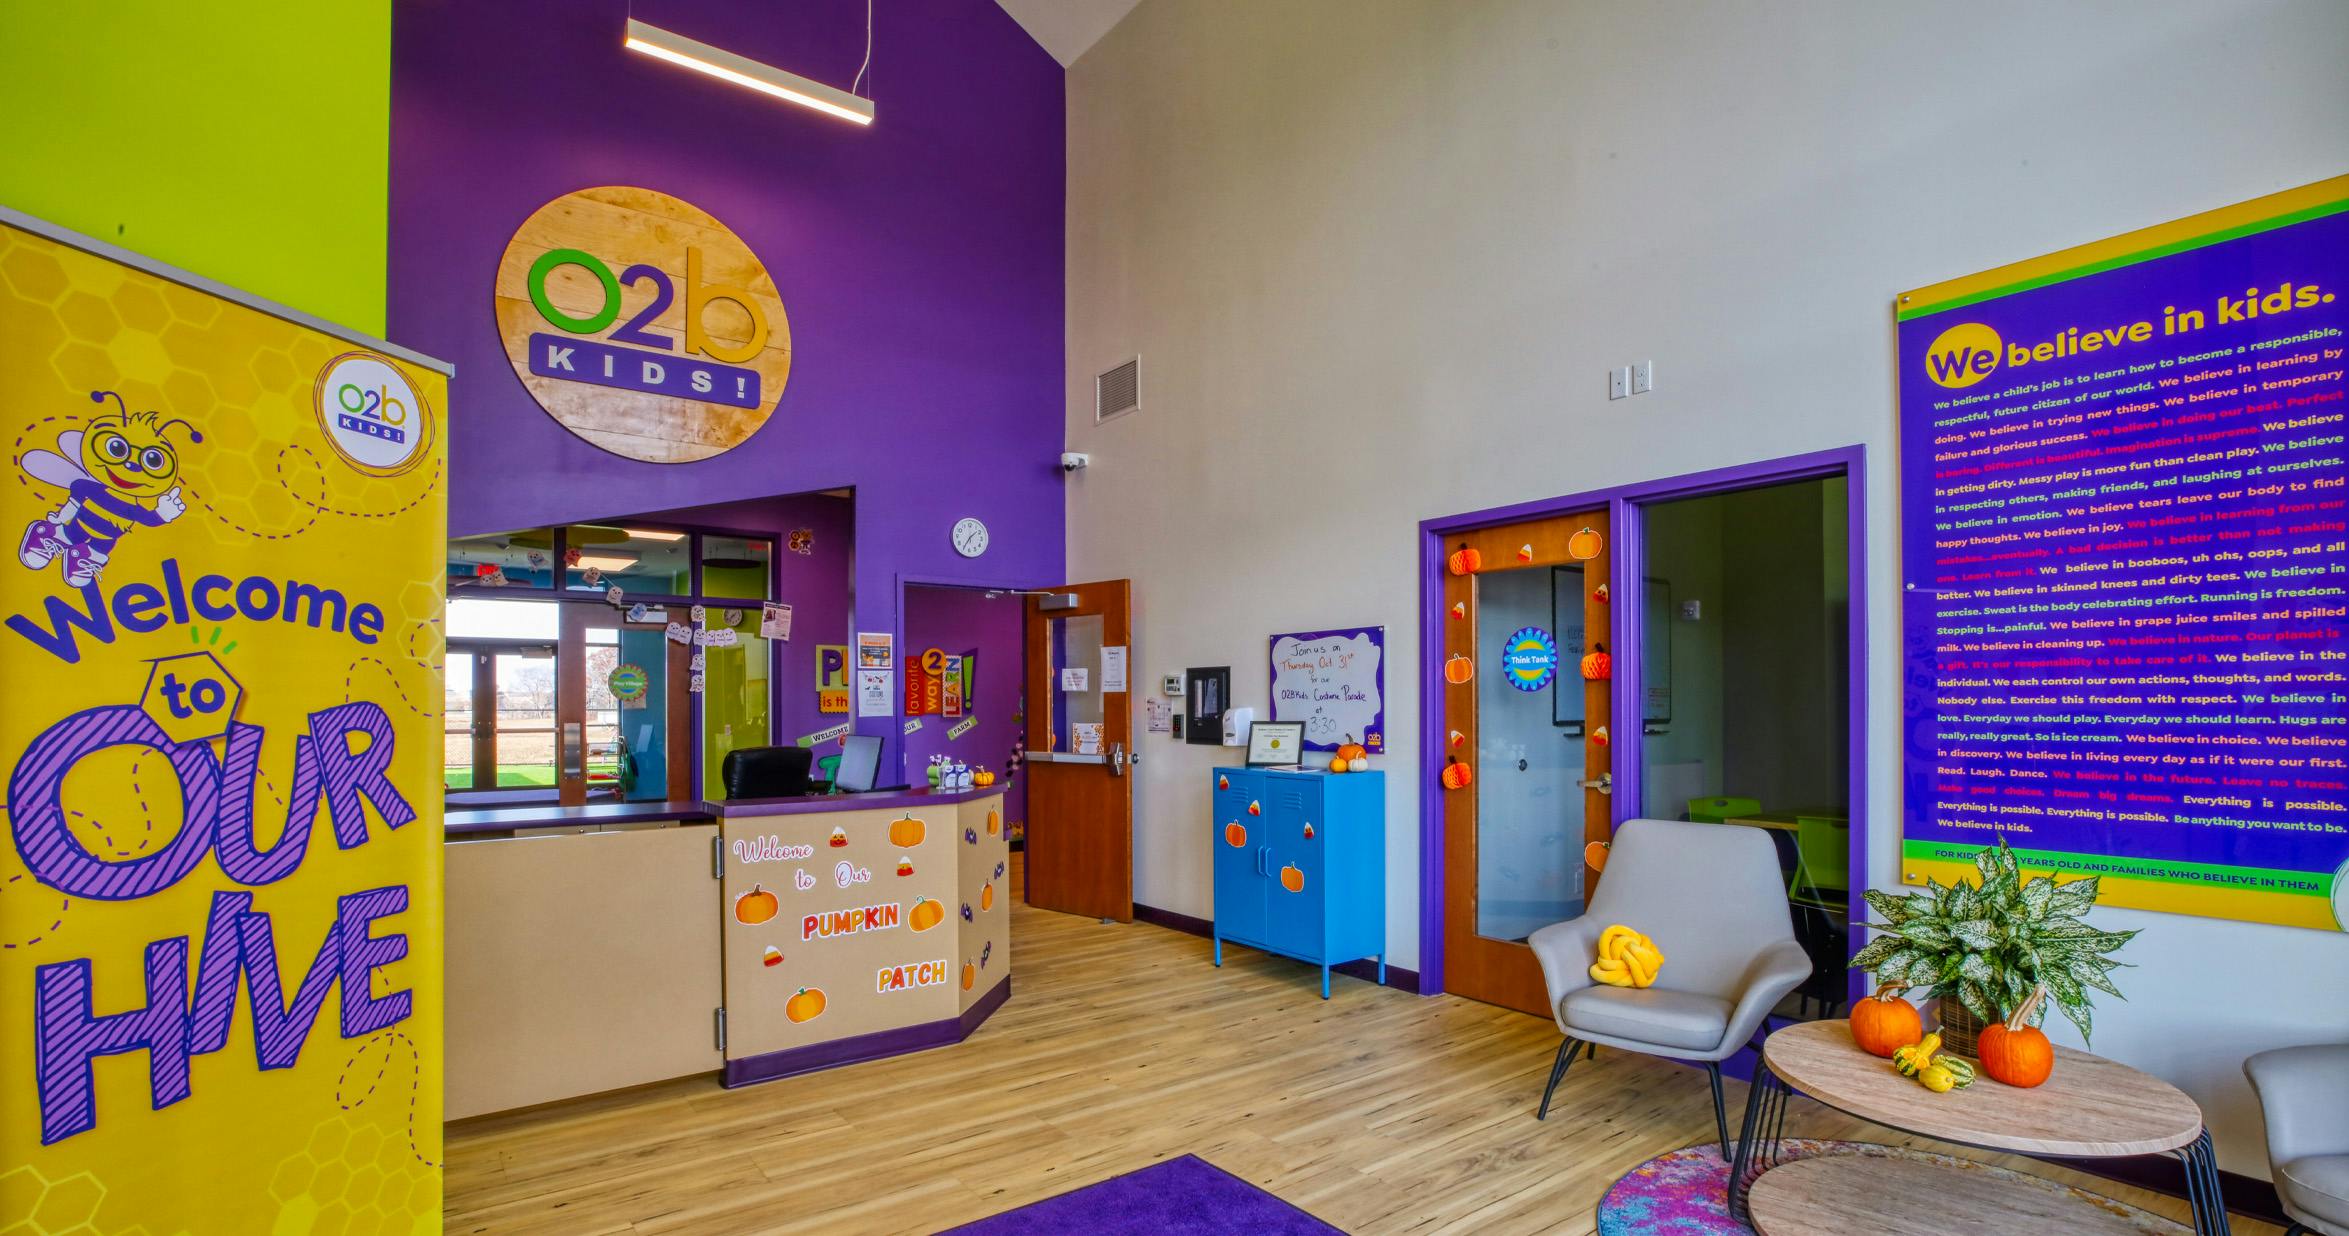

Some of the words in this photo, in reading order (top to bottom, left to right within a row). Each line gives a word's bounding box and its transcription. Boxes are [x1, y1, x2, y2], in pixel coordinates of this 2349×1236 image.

[1931, 345, 1996, 382] We
[2007, 324, 2153, 368] believe
[2163, 305, 2205, 336] in
[2217, 282, 2336, 325] kids.
[547, 345, 746, 400] KIDS!
[1933, 401, 1950, 410] We
[1952, 394, 1990, 406] believe
[2003, 384, 2039, 397] child's
[2041, 379, 2060, 392] job
[2063, 376, 2074, 386] is
[2076, 375, 2090, 383] to
[2094, 368, 2125, 380] learn
[2129, 362, 2156, 374] how
[2159, 359, 2174, 367] to
[2178, 348, 2232, 364] become
[2250, 327, 2342, 351] responsible,
[1934, 433, 1966, 444] doing.
[1969, 430, 1986, 438] We
[1989, 423, 2029, 435] believe
[2032, 419, 2043, 428] in
[2047, 414, 2083, 426] trying
[2087, 409, 2112, 419] new
[2115, 402, 2159, 414] things.
[2163, 396, 2184, 406] We
[2188, 388, 2238, 402] believe
[2243, 383, 2257, 393] in
[2261, 370, 2343, 390] temporary
[342, 417, 401, 441] KIDS!
[1935, 487, 1945, 496] in
[1946, 483, 1986, 496] getting
[1987, 479, 2016, 489] dirty.
[2018, 474, 2053, 485] Messy
[2055, 471, 2080, 482] play
[2081, 467, 2092, 477] is
[2094, 464, 2127, 475] more
[2128, 461, 2151, 470] fun
[2153, 457, 2184, 467] than
[2186, 451, 2223, 463] clean
[2226, 447, 2259, 459] play.
[2261, 442, 2285, 452] We
[2288, 435, 2344, 449] believe
[1935, 522, 1951, 530] We
[1955, 518, 1993, 528] believe
[1997, 515, 2008, 524] in
[2011, 510, 2062, 522] emotion.
[2066, 507, 2085, 516] We
[2089, 502, 2134, 514] believe
[2138, 498, 2172, 508] tears
[2177, 493, 2212, 504] leave
[2218, 490, 2242, 499] our
[2247, 484, 2284, 496] body
[2289, 482, 2306, 491] to
[2312, 476, 2344, 488] find
[1936, 591, 1971, 600] better.
[1973, 589, 1991, 597] We
[1993, 586, 2033, 596] believe
[2036, 584, 2048, 593] in
[2051, 581, 2097, 592] skinned
[2100, 580, 2137, 589] knees
[2141, 575, 2166, 586] and
[2169, 574, 2203, 584] dirty
[2205, 572, 2240, 581] tees.
[2243, 569, 2267, 579] We
[2271, 565, 2326, 577] believe
[2330, 563, 2345, 573] in
[4, 558, 385, 665] Welcome
[1936, 624, 1983, 635] Stopping
[1986, 621, 2046, 633] is...painful.
[2049, 621, 2068, 629] We
[2071, 618, 2115, 628] believe
[2118, 617, 2131, 626] in
[2134, 616, 2172, 627] grape
[2175, 613, 2208, 625] juice
[2212, 611, 2257, 622] smiles
[2261, 609, 2290, 619] and
[2295, 606, 2346, 619] spilled
[927, 651, 943, 670] 2
[1280, 658, 1315, 675] Thursday
[1318, 656, 1332, 669] Oct
[1511, 656, 1530, 664] Think
[1531, 655, 1549, 664] Tank
[160, 671, 226, 720] to
[906, 659, 920, 715] favorite
[927, 677, 941, 711] way
[1936, 677, 1991, 687] individual.
[1992, 678, 2010, 686] We
[2011, 677, 2039, 686] each
[2040, 676, 2083, 685] control
[2085, 677, 2107, 685] our
[2138, 674, 2190, 685] actions,
[2192, 673, 2260, 685] thoughts,
[2263, 672, 2291, 682] and
[2295, 671, 2347, 681] words.
[823, 696, 832, 707] is
[953, 721, 971, 734] FARM
[1937, 713, 1961, 722] love.
[1963, 714, 2012, 724] Everyday
[2032, 714, 2070, 722] should
[2073, 714, 2101, 724] play.
[2104, 714, 2161, 725] Everyday
[2185, 714, 2231, 723] should
[2234, 714, 2276, 724] learn.
[2279, 715, 2317, 726] Hugs
[7, 700, 417, 901] OUR
[1937, 818, 1953, 827] We
[1954, 819, 1992, 830] believe
[1994, 821, 2005, 830] in
[2006, 822, 2032, 832] kids.
[734, 836, 813, 863] Welcome
[796, 869, 815, 889] to
[835, 861, 871, 888] Our
[1935, 850, 1954, 858] FOR
[2020, 857, 2055, 868] YEARS
[2058, 861, 2081, 870] OLD
[2083, 863, 2109, 872] AND
[2111, 865, 2165, 877] FAMILIES
[2169, 870, 2200, 880] WHO
[2203, 872, 2257, 885] BELIEVE
[2261, 878, 2274, 887] IN
[2278, 880, 2319, 891] THEM
[802, 904, 899, 939] PUMPKIN
[877, 960, 946, 992] PATCH
[36, 884, 413, 1146] HIVE
